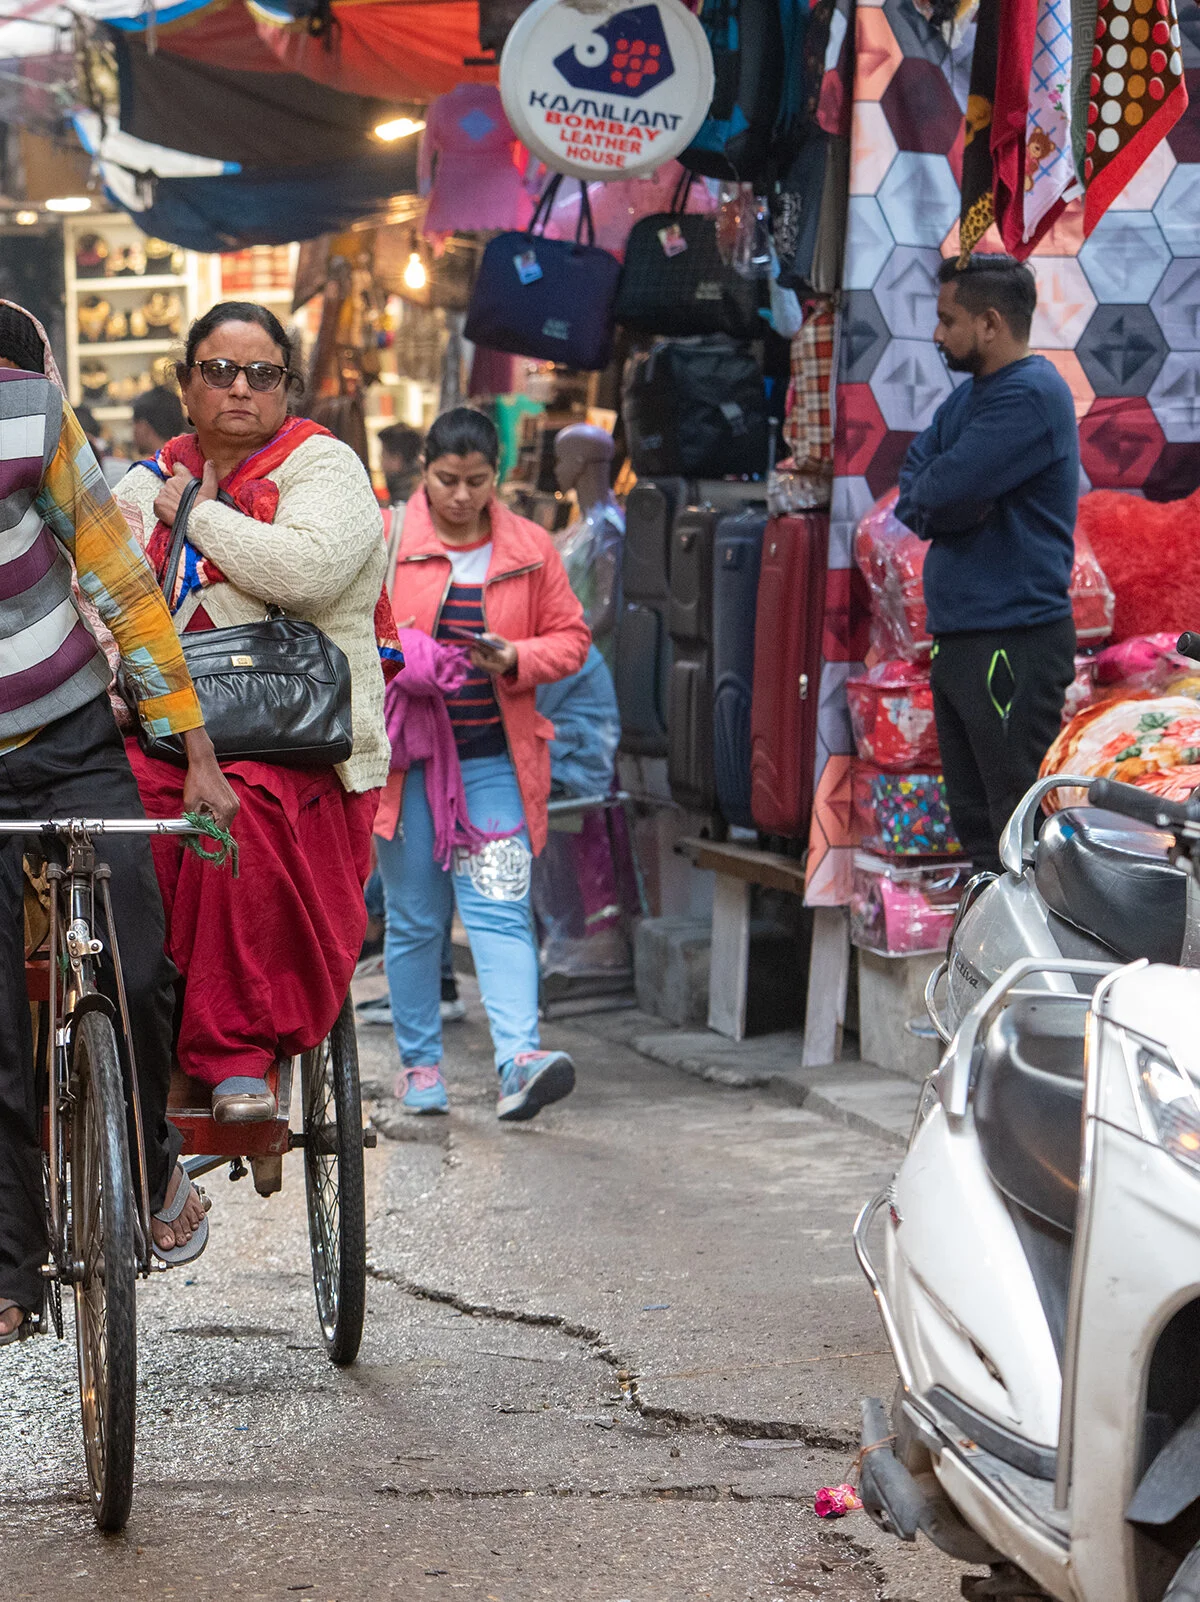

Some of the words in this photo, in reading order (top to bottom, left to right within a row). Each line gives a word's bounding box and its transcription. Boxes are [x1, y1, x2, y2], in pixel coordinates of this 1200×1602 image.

[529, 91, 683, 131] KAMILIANT
[545, 111, 661, 142] BOMBAY
[560, 129, 642, 154] LEATHER
[566, 146, 626, 168] HOUSE
